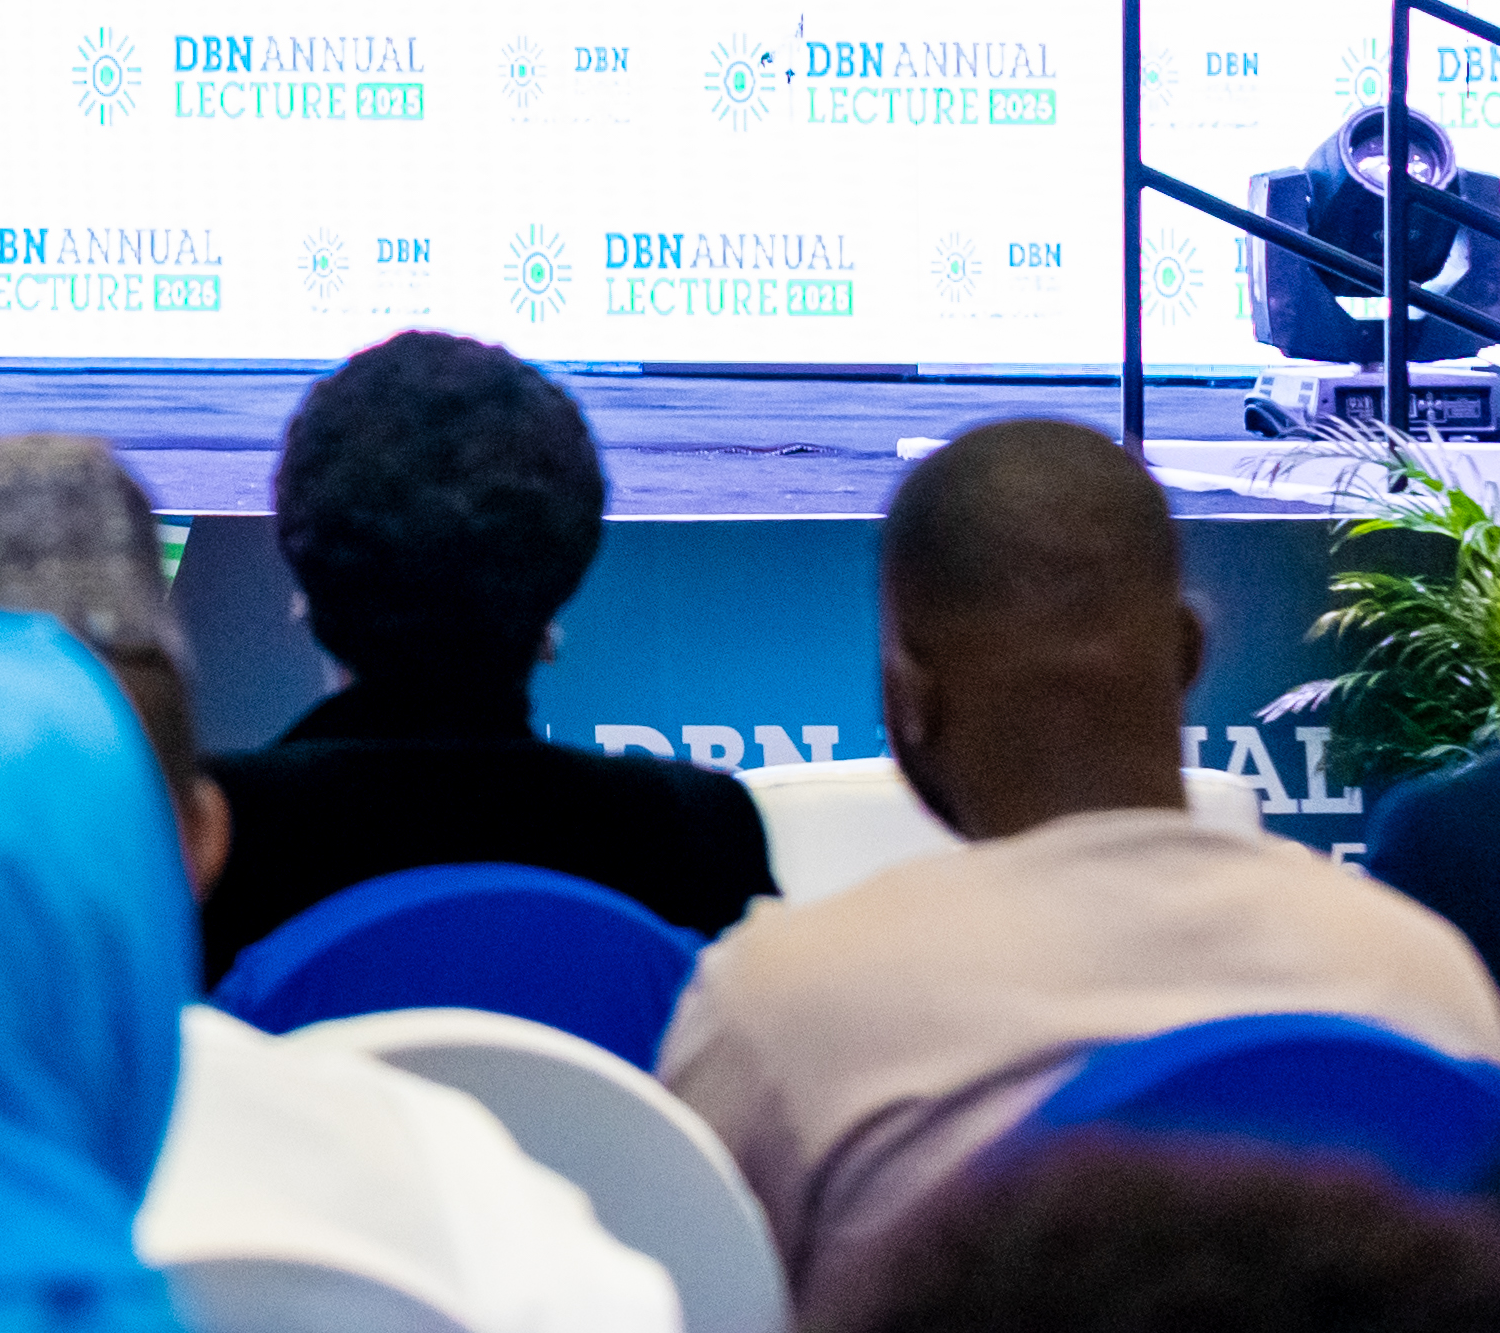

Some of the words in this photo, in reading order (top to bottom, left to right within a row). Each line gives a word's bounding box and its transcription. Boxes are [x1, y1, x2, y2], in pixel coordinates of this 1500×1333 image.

[174, 35, 254, 73] DBN
[260, 36, 424, 72] ANNUAL
[575, 47, 629, 72] DBN
[806, 41, 884, 78] DBN
[894, 42, 1055, 78] ANNUAL
[1206, 52, 1258, 76] DBN
[175, 81, 345, 119] LECTURE
[807, 87, 978, 125] LECTURE
[57, 228, 222, 265] ANNUAL
[377, 238, 430, 263] DBN
[605, 232, 685, 270] DBN
[690, 234, 854, 270] ANNUAL
[1009, 243, 1061, 267] DBN
[606, 277, 777, 315] LECTURE
